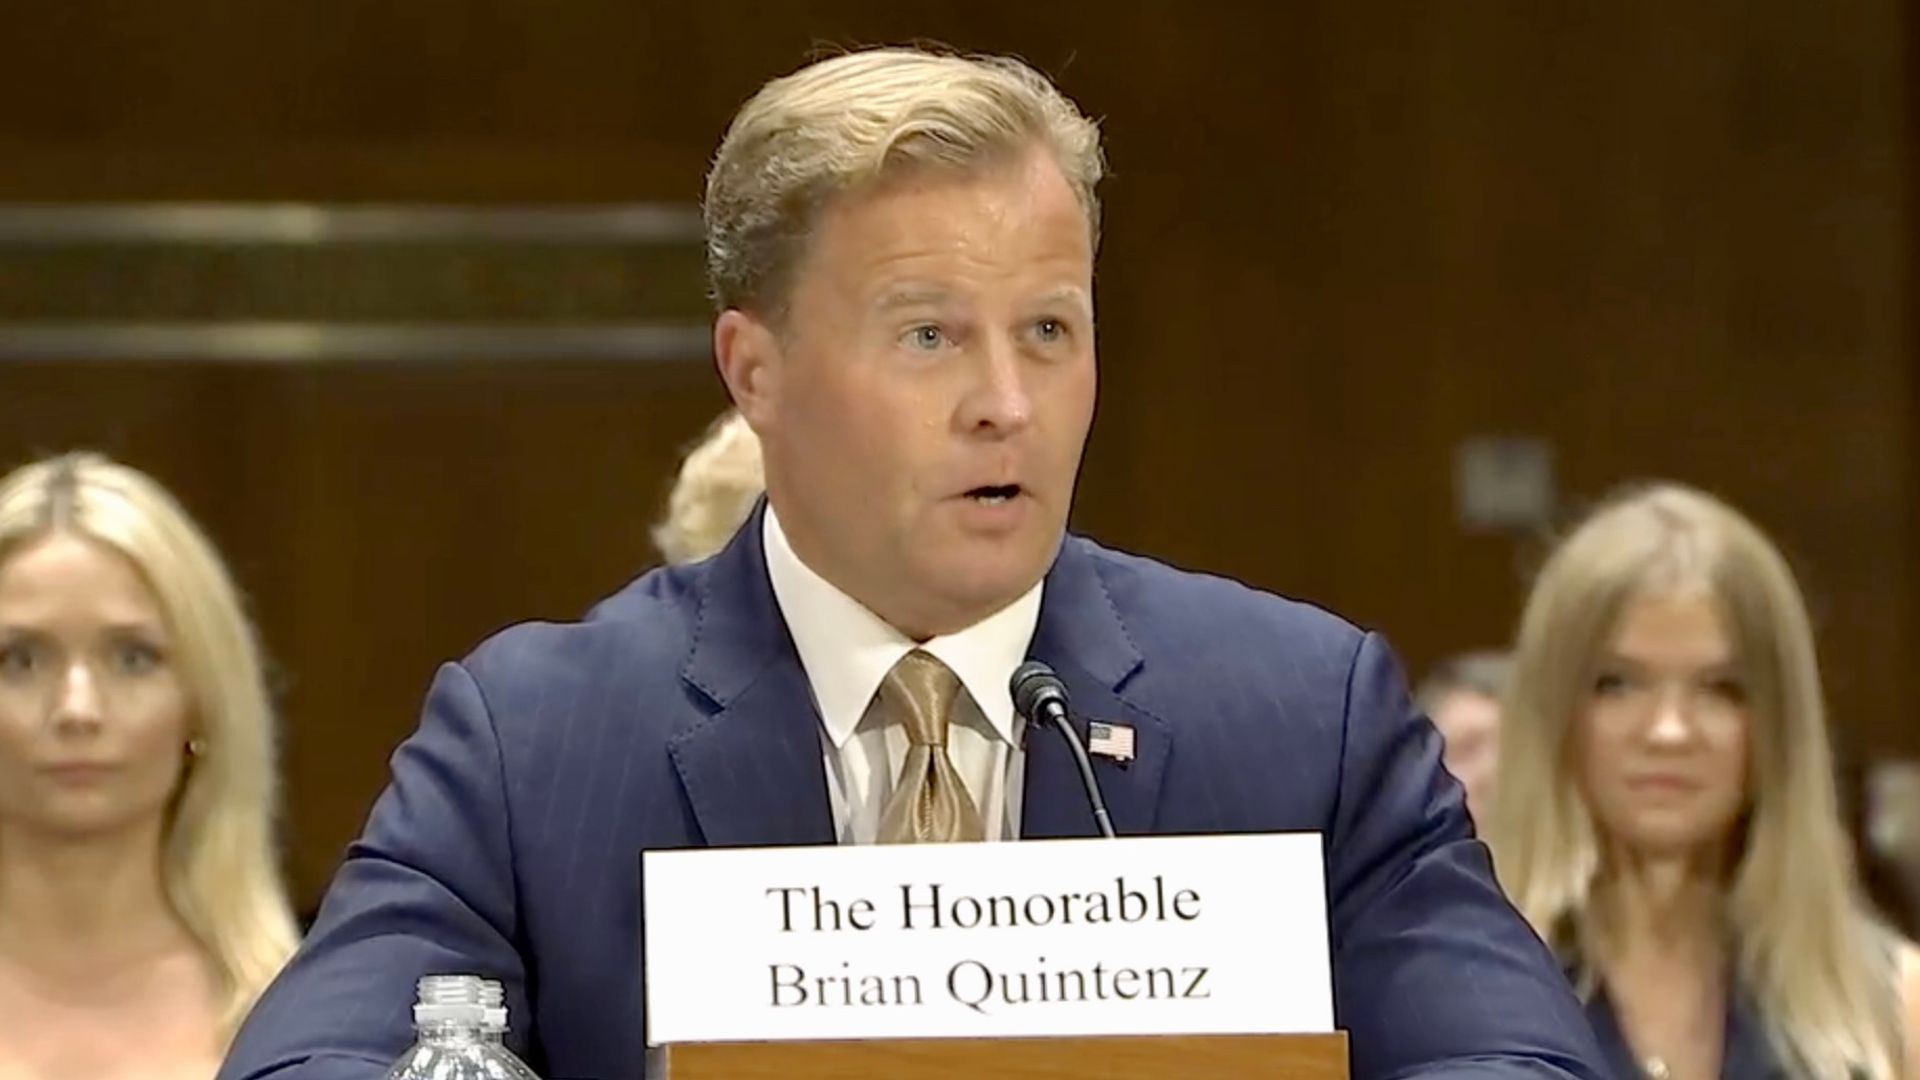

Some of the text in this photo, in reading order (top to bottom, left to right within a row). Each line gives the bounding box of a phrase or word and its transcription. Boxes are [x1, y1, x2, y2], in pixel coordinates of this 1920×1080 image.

[766, 875, 1201, 932] The Honorable
[768, 956, 1211, 1013] Brian Quintenz
